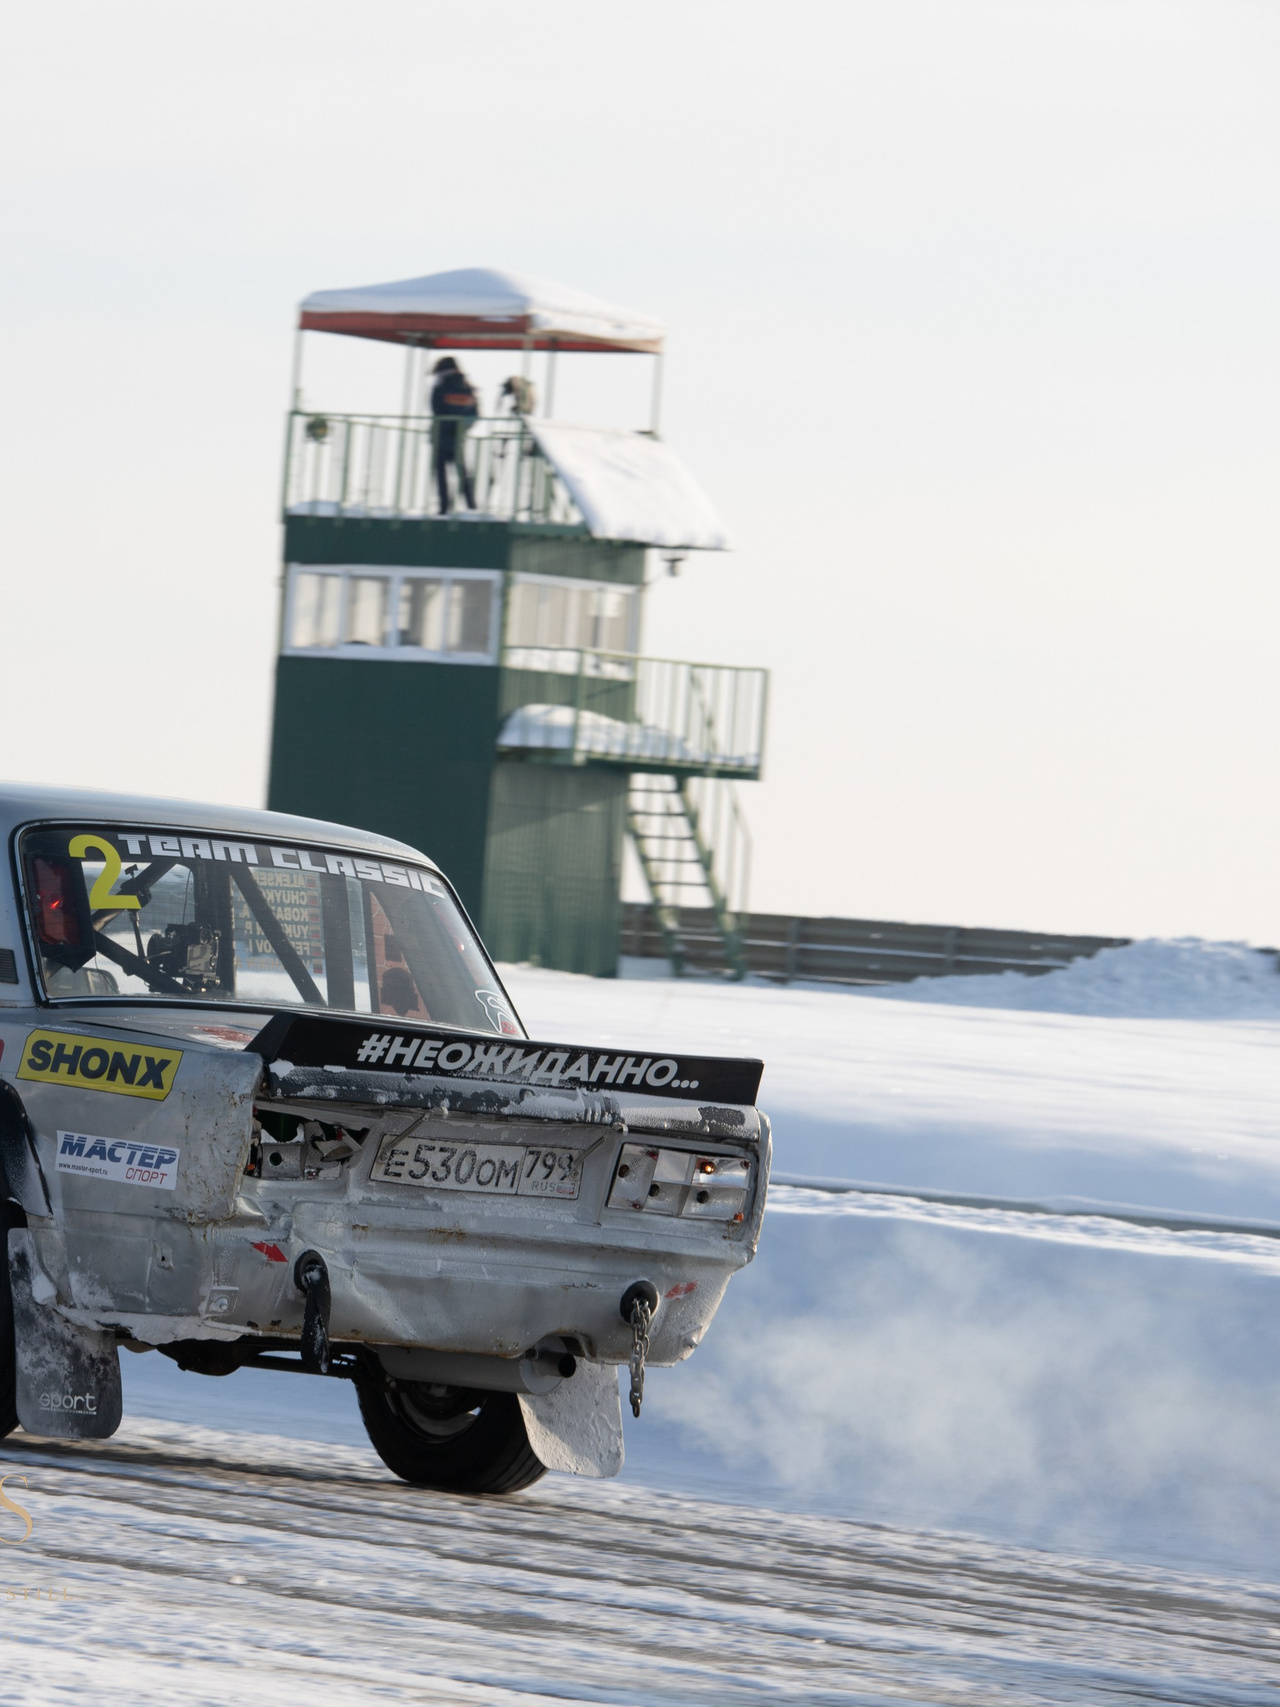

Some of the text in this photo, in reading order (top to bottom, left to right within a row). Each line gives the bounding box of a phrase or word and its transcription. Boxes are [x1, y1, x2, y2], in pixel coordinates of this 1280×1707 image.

[68, 834, 142, 910] 2
[118, 833, 446, 899] TEAM CLASSIC
[27, 1039, 172, 1090] SHONX
[357, 1033, 700, 1089] #НЕОЖИДАННО...
[58, 1162, 108, 1175] www.master-sport.ru
[60, 1134, 177, 1170] МАСТЕР
[125, 1167, 168, 1185] СПОРТ
[531, 1180, 556, 1193] RUS
[39, 1392, 97, 1411] sport
